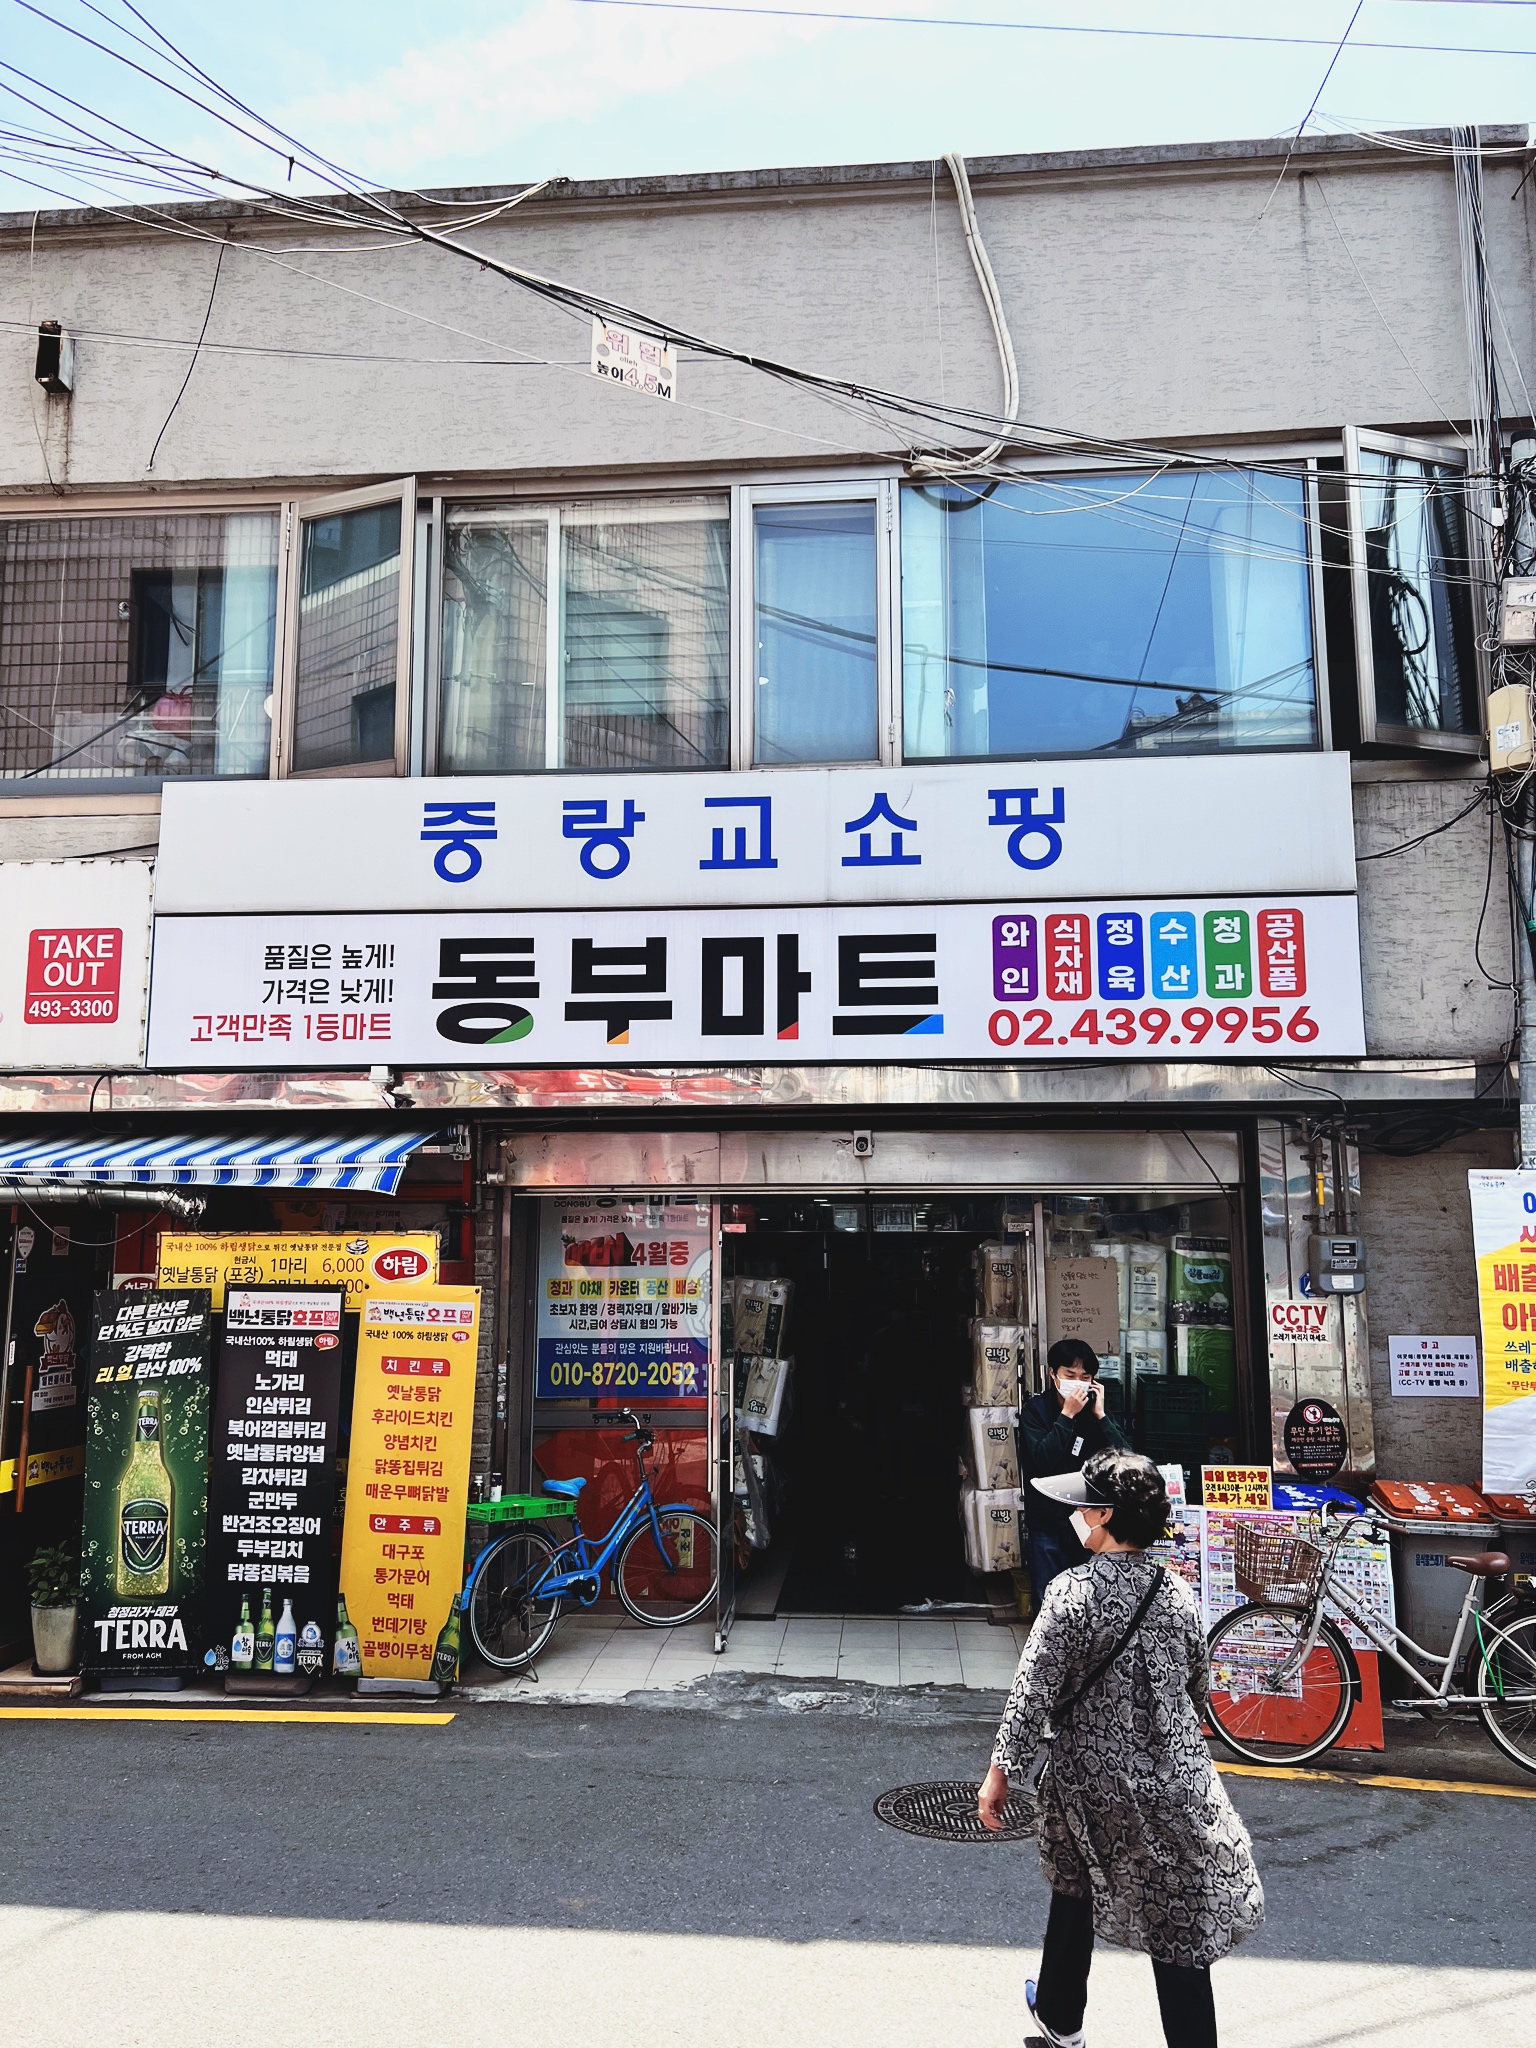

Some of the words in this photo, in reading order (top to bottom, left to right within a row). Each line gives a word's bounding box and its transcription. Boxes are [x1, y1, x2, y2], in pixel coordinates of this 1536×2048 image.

[420, 786, 1066, 883] 중랑교쇼핑
[37, 934, 115, 960] TAKE
[1000, 919, 1031, 994] 와인
[1053, 918, 1084, 994] 식자재
[1105, 917, 1136, 993] 정육
[1158, 917, 1191, 992] 수산
[1212, 916, 1244, 991] 청과
[1264, 914, 1298, 992] 공산품
[263, 943, 333, 972] 품질은
[341, 942, 396, 970] 높게!
[43, 961, 105, 988] OUT
[262, 978, 331, 1005] 가격은
[339, 977, 395, 1004] 낮게!
[431, 932, 944, 1046] 동부마트
[28, 998, 114, 1019] 493-3300
[190, 1014, 293, 1043] 고객만족
[303, 1012, 393, 1042] 1등마트
[987, 1005, 1320, 1047] 02.439.9956
[553, 1200, 591, 1208] DONGBU
[561, 1215, 581, 1224] 품질은
[583, 1214, 598, 1224] 높게!
[600, 1215, 619, 1224] 가격은
[166, 1242, 193, 1252] 국내산
[195, 1243, 218, 1252] 100%
[220, 1242, 271, 1252] 하림생닭으로
[273, 1243, 288, 1252] 튀긴
[290, 1243, 318, 1252] 옛날통닭
[321, 1243, 342, 1252] 전문점
[564, 1232, 634, 1267] OPEN
[631, 1241, 690, 1266] 4월중
[234, 1255, 257, 1265] 현금시
[382, 1256, 418, 1276] 하림
[162, 1266, 219, 1283] 옛날통닭
[223, 1266, 264, 1284] (포장)
[271, 1257, 307, 1274] 1마리
[322, 1257, 365, 1275] 6,000
[991, 1263, 1014, 1277] 리빙
[550, 1280, 573, 1296] 청과
[580, 1280, 602, 1296] 야채
[609, 1280, 640, 1296] 카운터
[646, 1280, 669, 1296] 공산
[675, 1280, 698, 1295] 배송
[116, 1304, 145, 1322] 다른
[147, 1299, 190, 1319] 탄산은
[550, 1303, 577, 1316] 초보자
[579, 1303, 598, 1316] 환영
[607, 1303, 651, 1316] 경력자우대
[661, 1302, 698, 1316] 알바가능
[745, 1299, 764, 1313] 리빙
[1272, 1304, 1328, 1326] CCTV
[174, 1314, 204, 1333] 않은
[569, 1319, 608, 1331] 시간,급여
[610, 1319, 637, 1330] 상담시
[639, 1318, 658, 1330] 협의
[660, 1318, 679, 1330] 가능
[1282, 1324, 1322, 1334] 녹화중
[225, 1335, 276, 1347] 국내산100%
[278, 1336, 314, 1347] 하림생닭
[318, 1337, 334, 1347] 하림
[364, 1329, 389, 1340] 국내산
[392, 1330, 414, 1340] 100%
[416, 1331, 449, 1342] 하림생닭
[454, 1332, 467, 1341] 하림
[1272, 1333, 1290, 1342] 쓰레기
[1291, 1333, 1309, 1342] 버리지
[124, 1341, 173, 1363] 강력한
[555, 1343, 589, 1355] 관심있는
[592, 1343, 617, 1355] 분들의
[619, 1343, 636, 1355] 많은
[639, 1342, 692, 1355] 지원바랍니다.
[985, 1348, 1010, 1364] 리빙
[165, 1356, 203, 1376] 100%
[265, 1350, 298, 1368] 먹태
[254, 1373, 305, 1392] 노가리
[550, 1361, 696, 1386] 010-8720-2052
[1398, 1369, 1410, 1377] 고발
[386, 1384, 442, 1403] 옛날통닭
[246, 1396, 312, 1415] 인삼튀김
[137, 1416, 158, 1426] TERRA
[371, 1408, 453, 1428] 후라이드치킨
[227, 1419, 327, 1440] 북어껍질튀김
[987, 1427, 1008, 1440] 리빙
[1290, 1426, 1306, 1437] 무단
[1308, 1426, 1323, 1436] 투기
[1324, 1425, 1340, 1436] 없는
[383, 1434, 437, 1452] 양념치킨
[226, 1443, 326, 1463] 옛날통닭양념
[241, 1467, 308, 1487] 감자튀김
[374, 1458, 444, 1477] 닭똥집튀김
[1226, 1470, 1268, 1483] 한정수량
[365, 1483, 450, 1503] 매운무뼈닭발
[1205, 1483, 1217, 1492] 오전
[248, 1491, 298, 1511] 군만두
[1205, 1493, 1242, 1505] 초특가
[1244, 1493, 1268, 1506] 세일
[222, 1514, 322, 1536] 반건조오징어
[991, 1509, 1012, 1523] 리빙
[124, 1520, 165, 1536] TERRA
[237, 1539, 304, 1559] 두부김치
[382, 1543, 425, 1561] 대구포
[227, 1563, 310, 1584] 닭똥집볶음
[373, 1567, 430, 1586] 통가문어
[387, 1592, 415, 1610] 먹태
[107, 1606, 179, 1619] 청정라거-테라
[1344, 1606, 1370, 1632] PRAHA
[94, 1618, 189, 1653] TERRA
[371, 1616, 428, 1636] 번데기탕
[145, 1652, 162, 1660] AGM
[362, 1640, 434, 1661] 골뱅이무침
[436, 1651, 457, 1664] TERRA
[298, 1655, 324, 1667] TERRA
